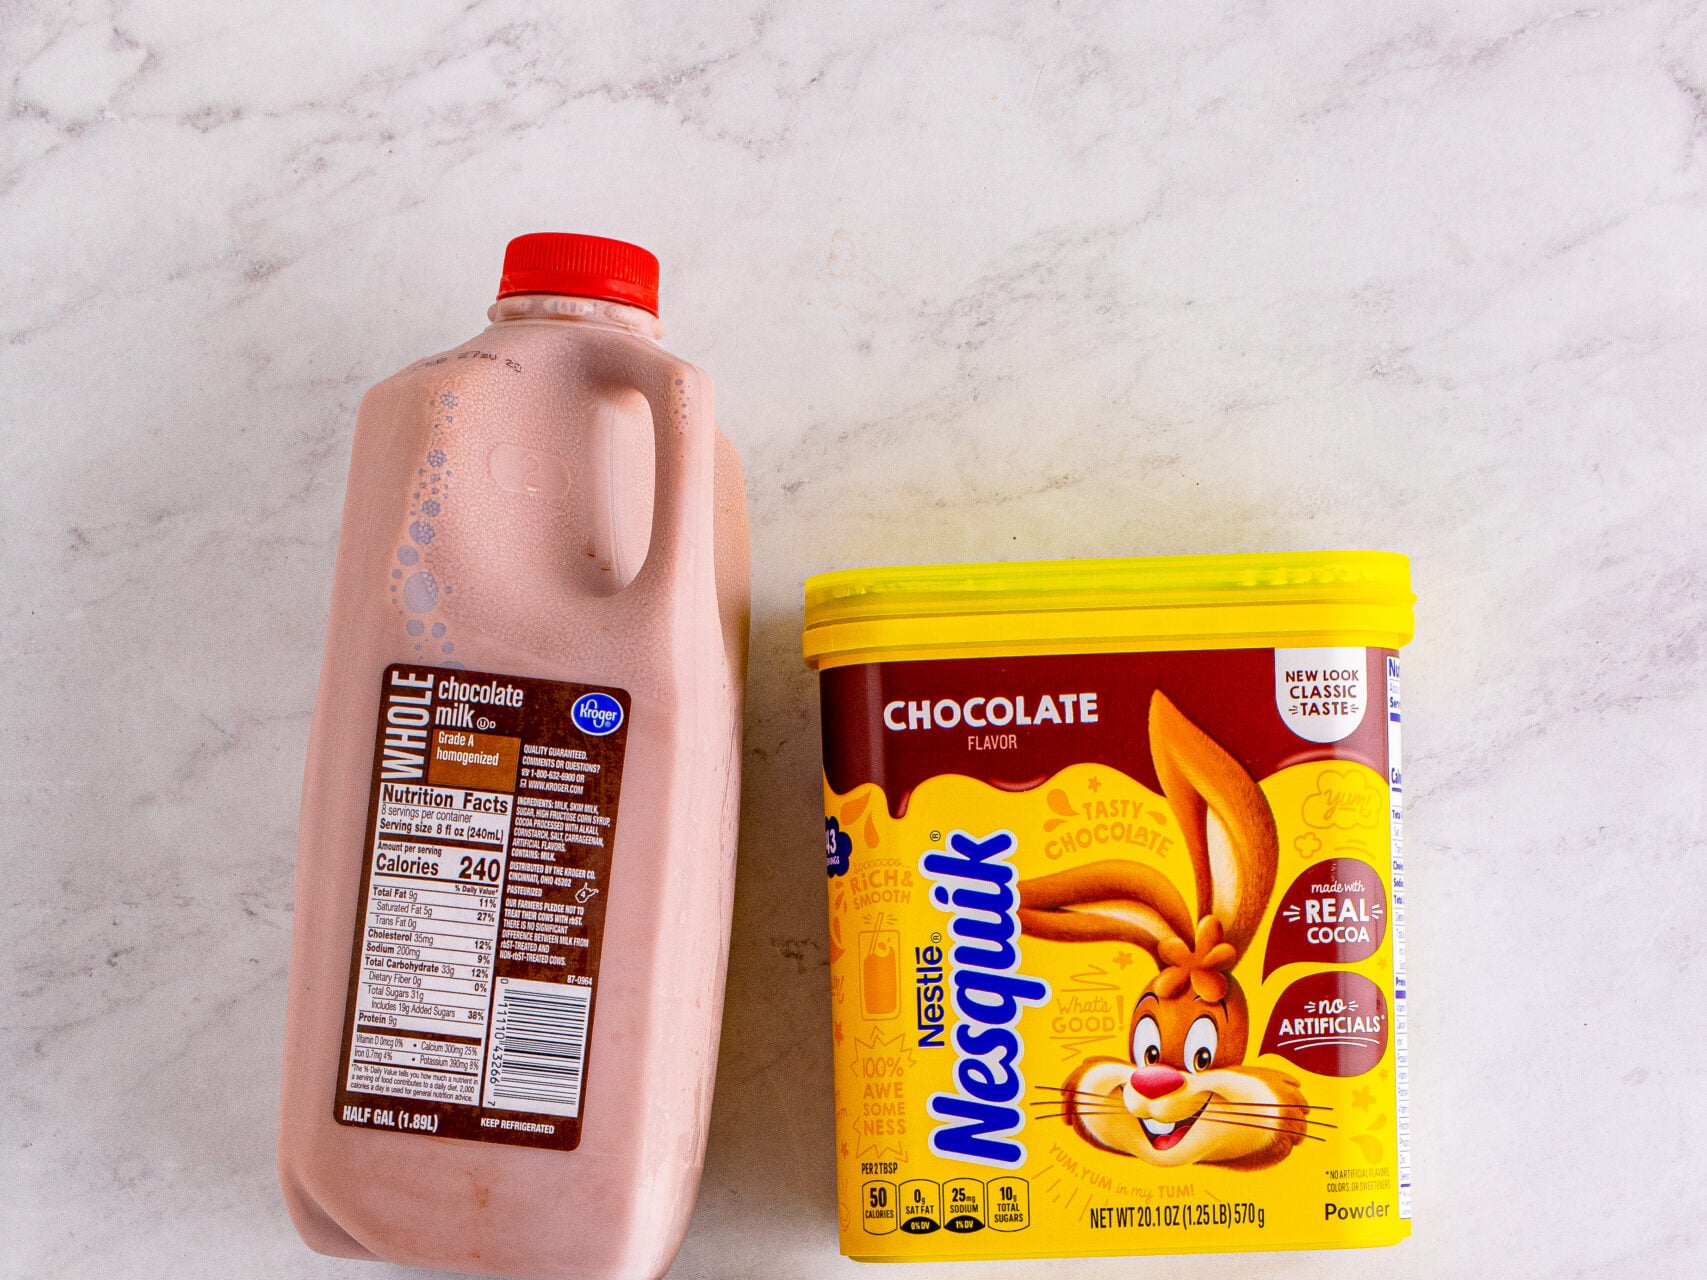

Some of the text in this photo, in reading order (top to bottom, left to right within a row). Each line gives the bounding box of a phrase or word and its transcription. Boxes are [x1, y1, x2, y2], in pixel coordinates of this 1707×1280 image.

[1285, 670, 1359, 682] NEW LOOK
[438, 676, 524, 708] chocolate
[1290, 684, 1357, 699] CLASSIC
[436, 704, 473, 728] milk
[579, 699, 618, 728] Kroger
[884, 692, 1098, 731] CHOCOLATE
[1300, 702, 1348, 716] TASTE
[381, 671, 434, 779] WHOLE
[438, 732, 474, 747] Grade A
[968, 734, 1017, 750] FLAVOR
[437, 748, 499, 766] homogenized
[528, 780, 584, 794] WWW.KROGER.COM
[382, 784, 508, 814] Nutrition Facts
[1082, 799, 1145, 821] TASTY
[380, 818, 504, 842] Serving size 8 fl oz (240mL)
[1043, 821, 1174, 861] CHOCOLATE
[376, 853, 500, 882] Calories 240
[373, 887, 418, 901] Total Fat 9g
[1311, 880, 1365, 893] made with
[479, 898, 496, 908] 11%
[853, 890, 911, 910] SMOOTH
[1305, 898, 1369, 923] REAL
[1307, 927, 1370, 944] COCOA
[566, 975, 592, 986] 87-0964
[922, 832, 1047, 1164] Nesquik
[1056, 996, 1112, 1015] What's
[1318, 998, 1345, 1014] no
[862, 1056, 904, 1079] 100%
[863, 1082, 903, 1099] AWE
[863, 1103, 905, 1117] SOME
[343, 1106, 438, 1132] HALF GAL (1.89L)
[480, 1118, 554, 1134] KEEP REFRIGERATED
[864, 1119, 906, 1136] NESS
[870, 1187, 887, 1207] 50
[914, 1189, 925, 1204] 0g
[952, 1187, 975, 1203] 25mg
[1000, 1186, 1017, 1201] 10g
[865, 1209, 894, 1219] CALORIES
[906, 1204, 934, 1214] SAT FAT
[950, 1203, 978, 1213] SODIUM
[997, 1202, 1019, 1212] TOTAL
[1325, 1200, 1390, 1220] Powder
[994, 1213, 1023, 1223] SUGARS
[1090, 1202, 1265, 1231] NET WT 20.1 OZ (1.25 LB) 570 g
